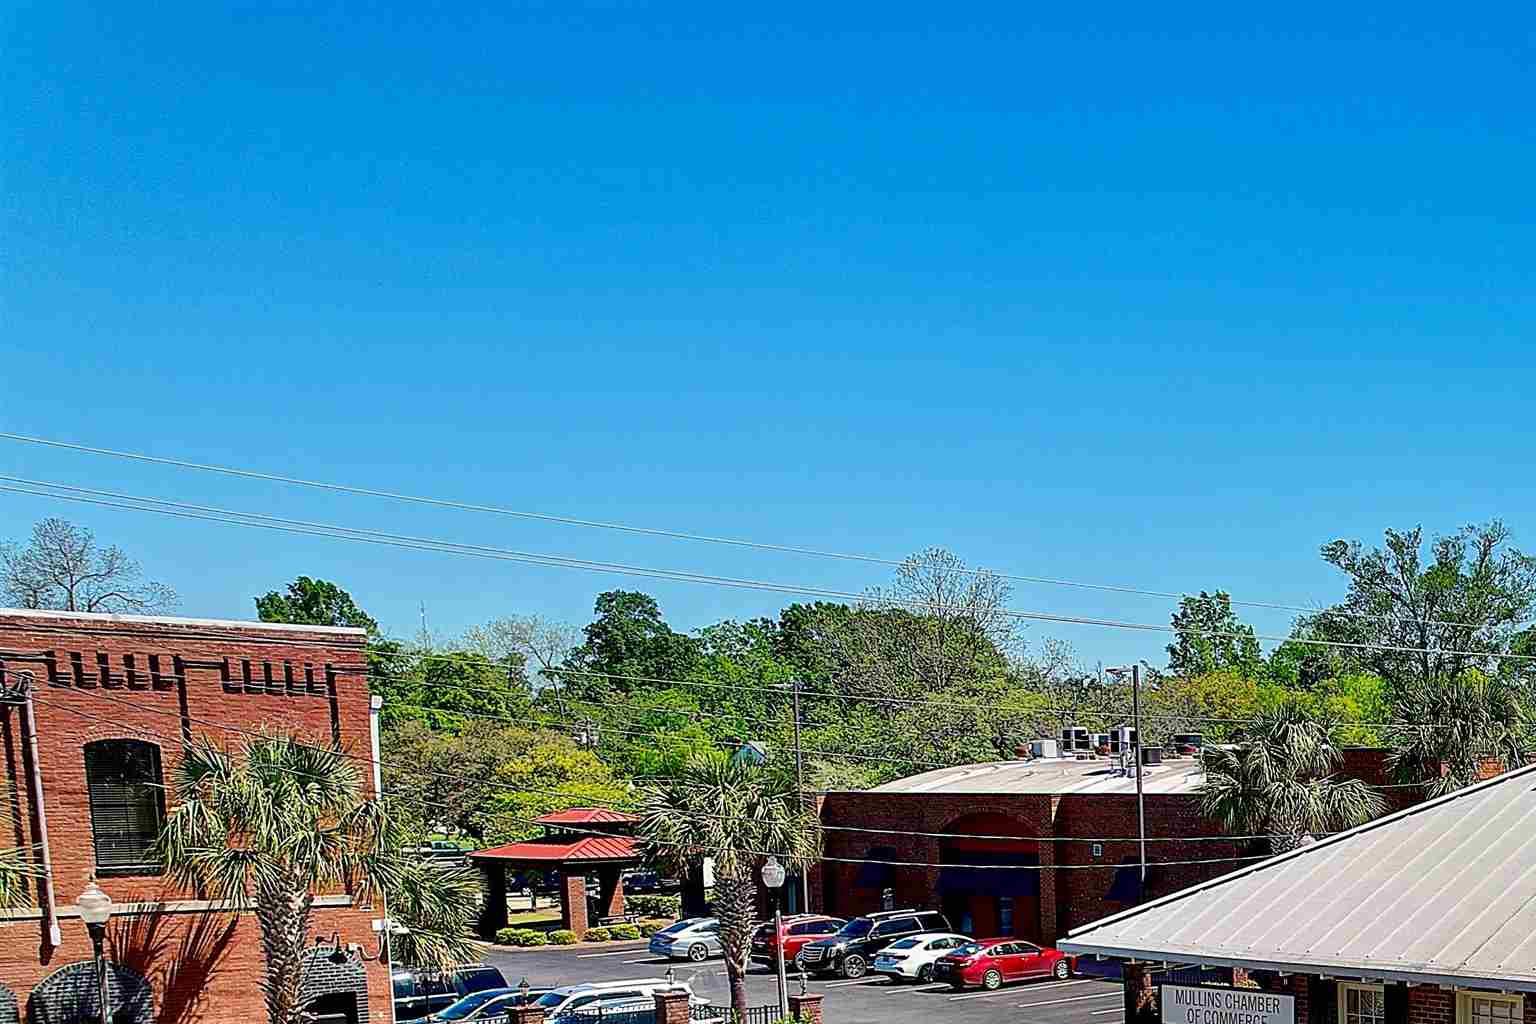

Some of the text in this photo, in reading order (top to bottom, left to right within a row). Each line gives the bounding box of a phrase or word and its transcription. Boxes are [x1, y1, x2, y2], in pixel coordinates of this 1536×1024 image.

[1175, 989, 1281, 1014] MULLINS CHAMBER
[1187, 1008, 1201, 1024] OF
